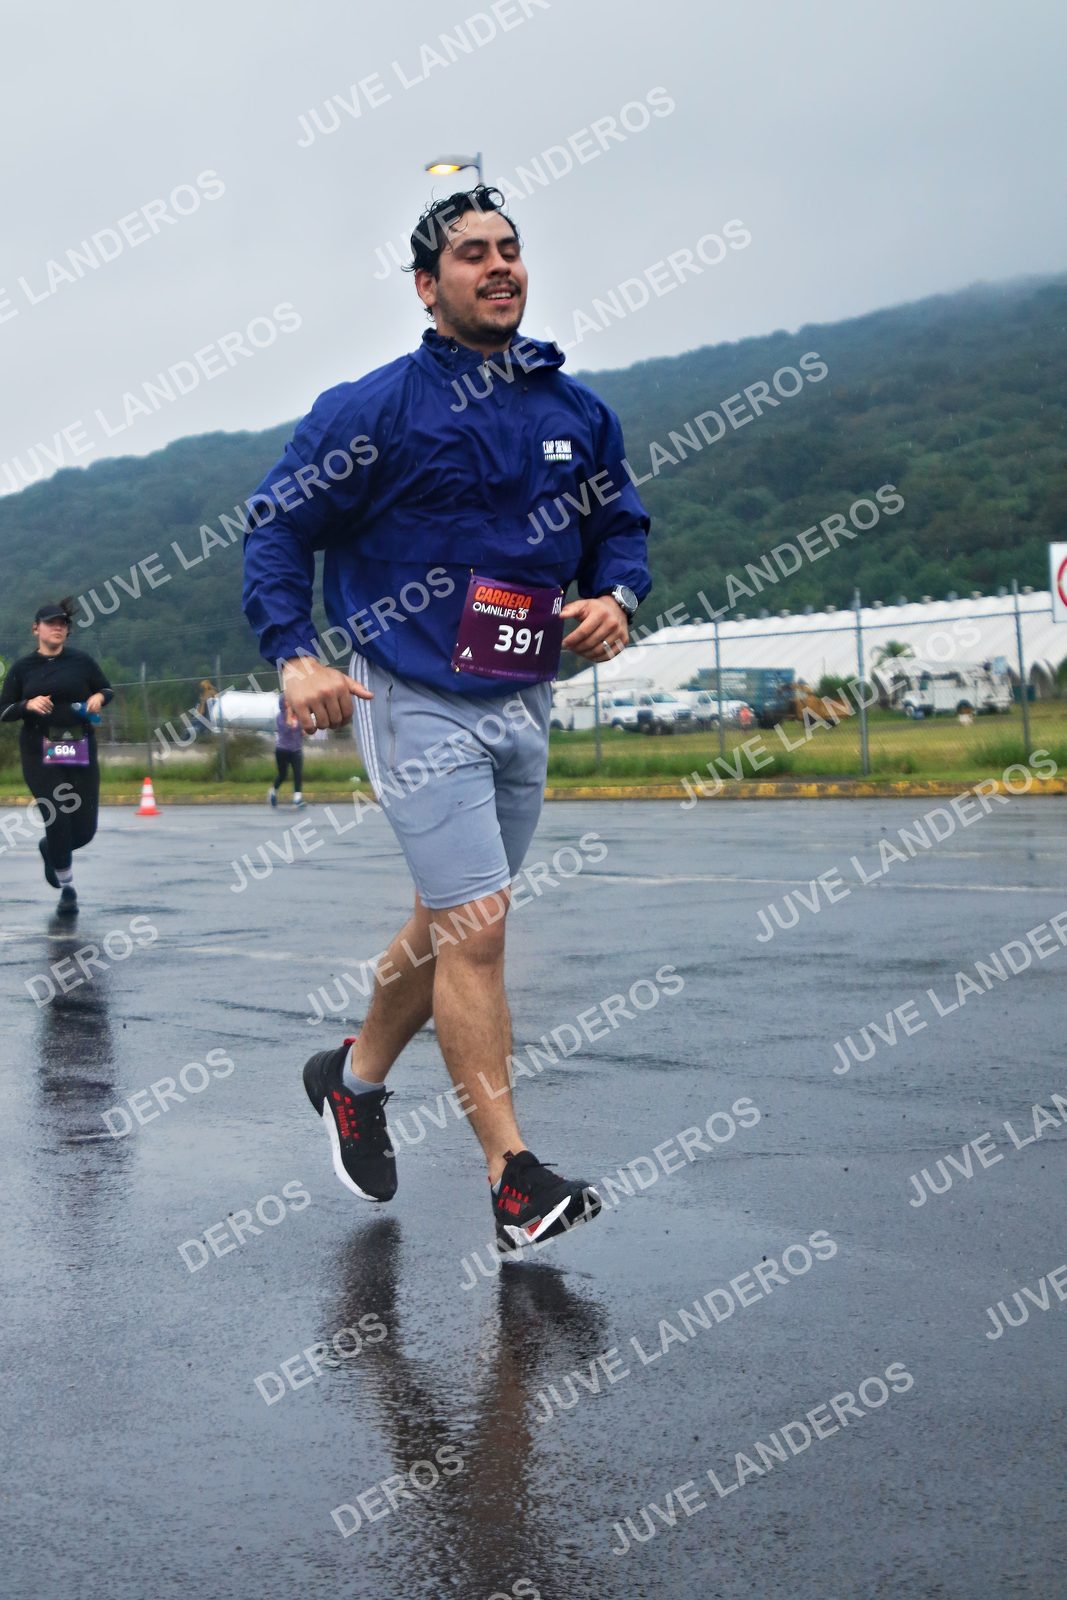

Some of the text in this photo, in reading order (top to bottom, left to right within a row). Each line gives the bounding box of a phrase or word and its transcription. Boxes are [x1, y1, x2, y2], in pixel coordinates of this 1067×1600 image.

[475, 586, 532, 608] CARRERA
[473, 602, 516, 619] OMNILIFE
[494, 624, 544, 655] 391
[54, 745, 76, 756] 604
